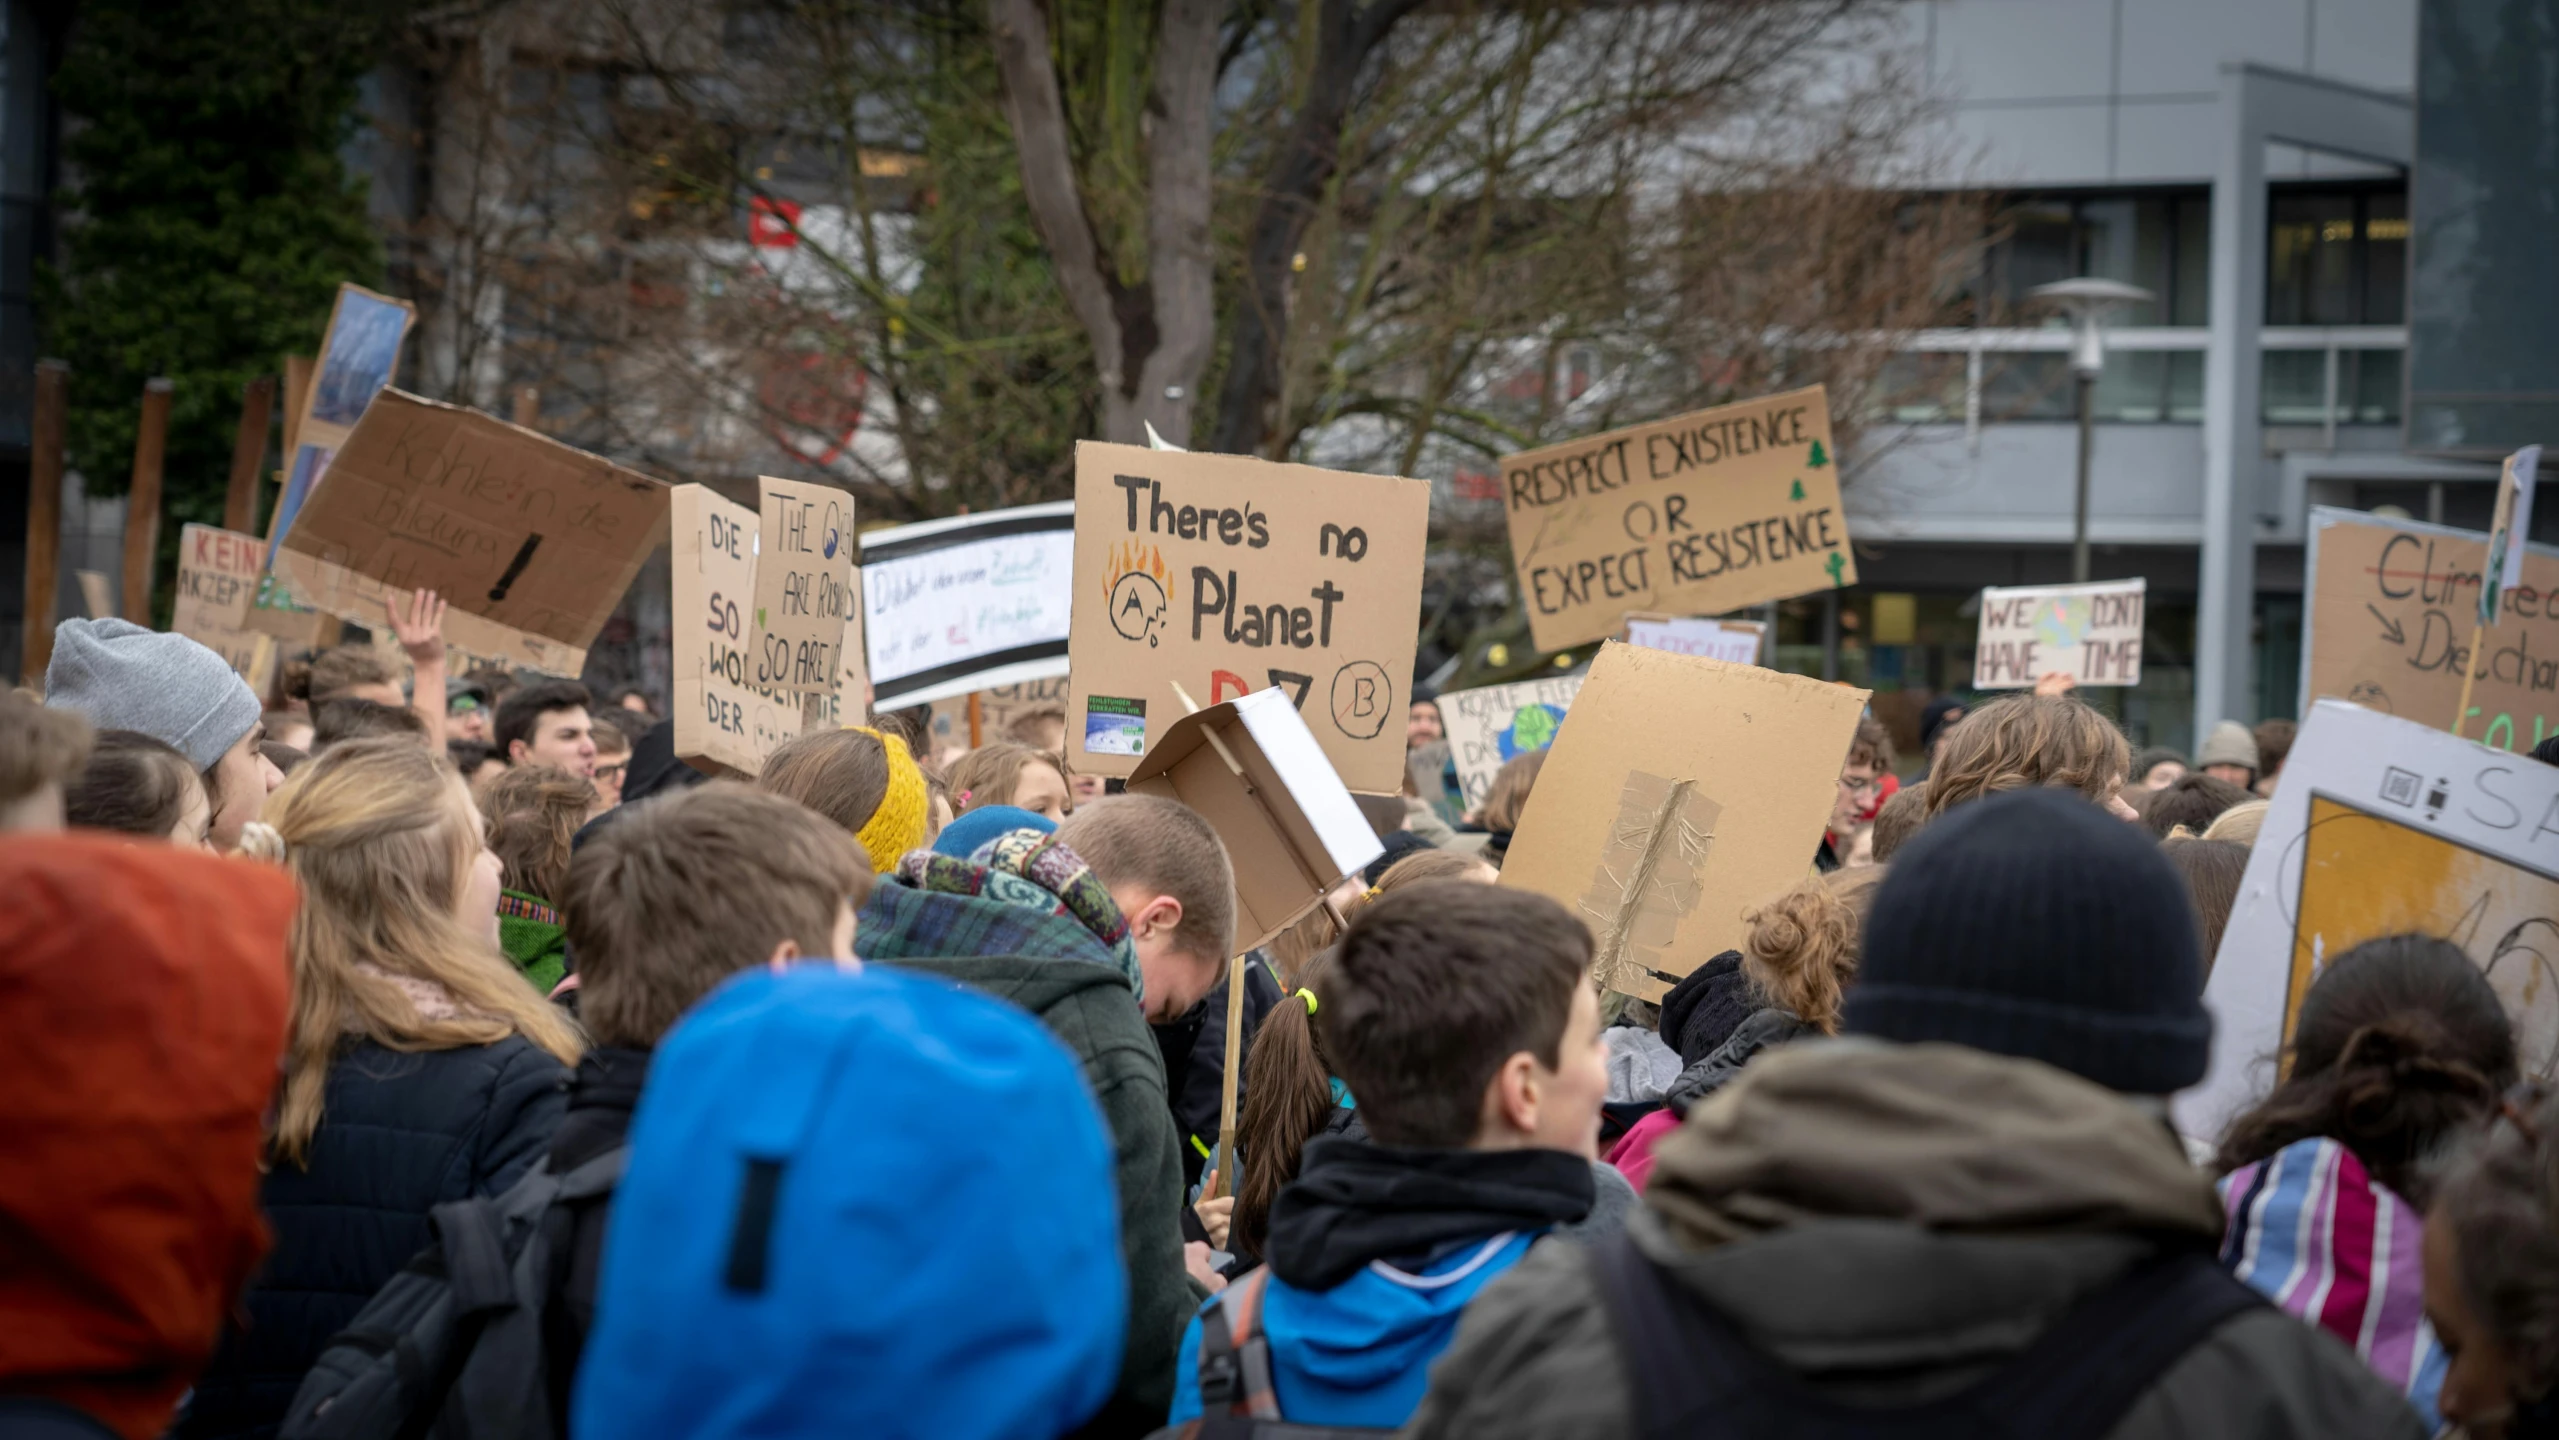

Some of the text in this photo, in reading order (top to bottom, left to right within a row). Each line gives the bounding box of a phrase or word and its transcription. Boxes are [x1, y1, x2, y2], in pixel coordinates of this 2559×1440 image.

[385, 419, 507, 504] Kohle
[1509, 438, 1631, 512] RESPECT
[1646, 406, 1809, 481] EXISTENCE
[363, 488, 497, 579] Bildung
[768, 492, 816, 553] THE
[1113, 474, 1369, 563] There's no
[1622, 493, 1693, 543] OR
[1531, 507, 1840, 616] EXPECT RESISTENCE
[2378, 533, 2539, 618] Climte
[706, 590, 741, 641] SO
[782, 570, 815, 618] ARE
[1191, 565, 1345, 649] Planet
[1984, 596, 2035, 630] WE
[759, 632, 791, 684] SO
[794, 639, 827, 686] ARE
[1976, 638, 2140, 682] HAVE TIME
[707, 691, 746, 737] DER
[1353, 677, 1376, 717] B
[1455, 685, 1519, 719] KOHLE
